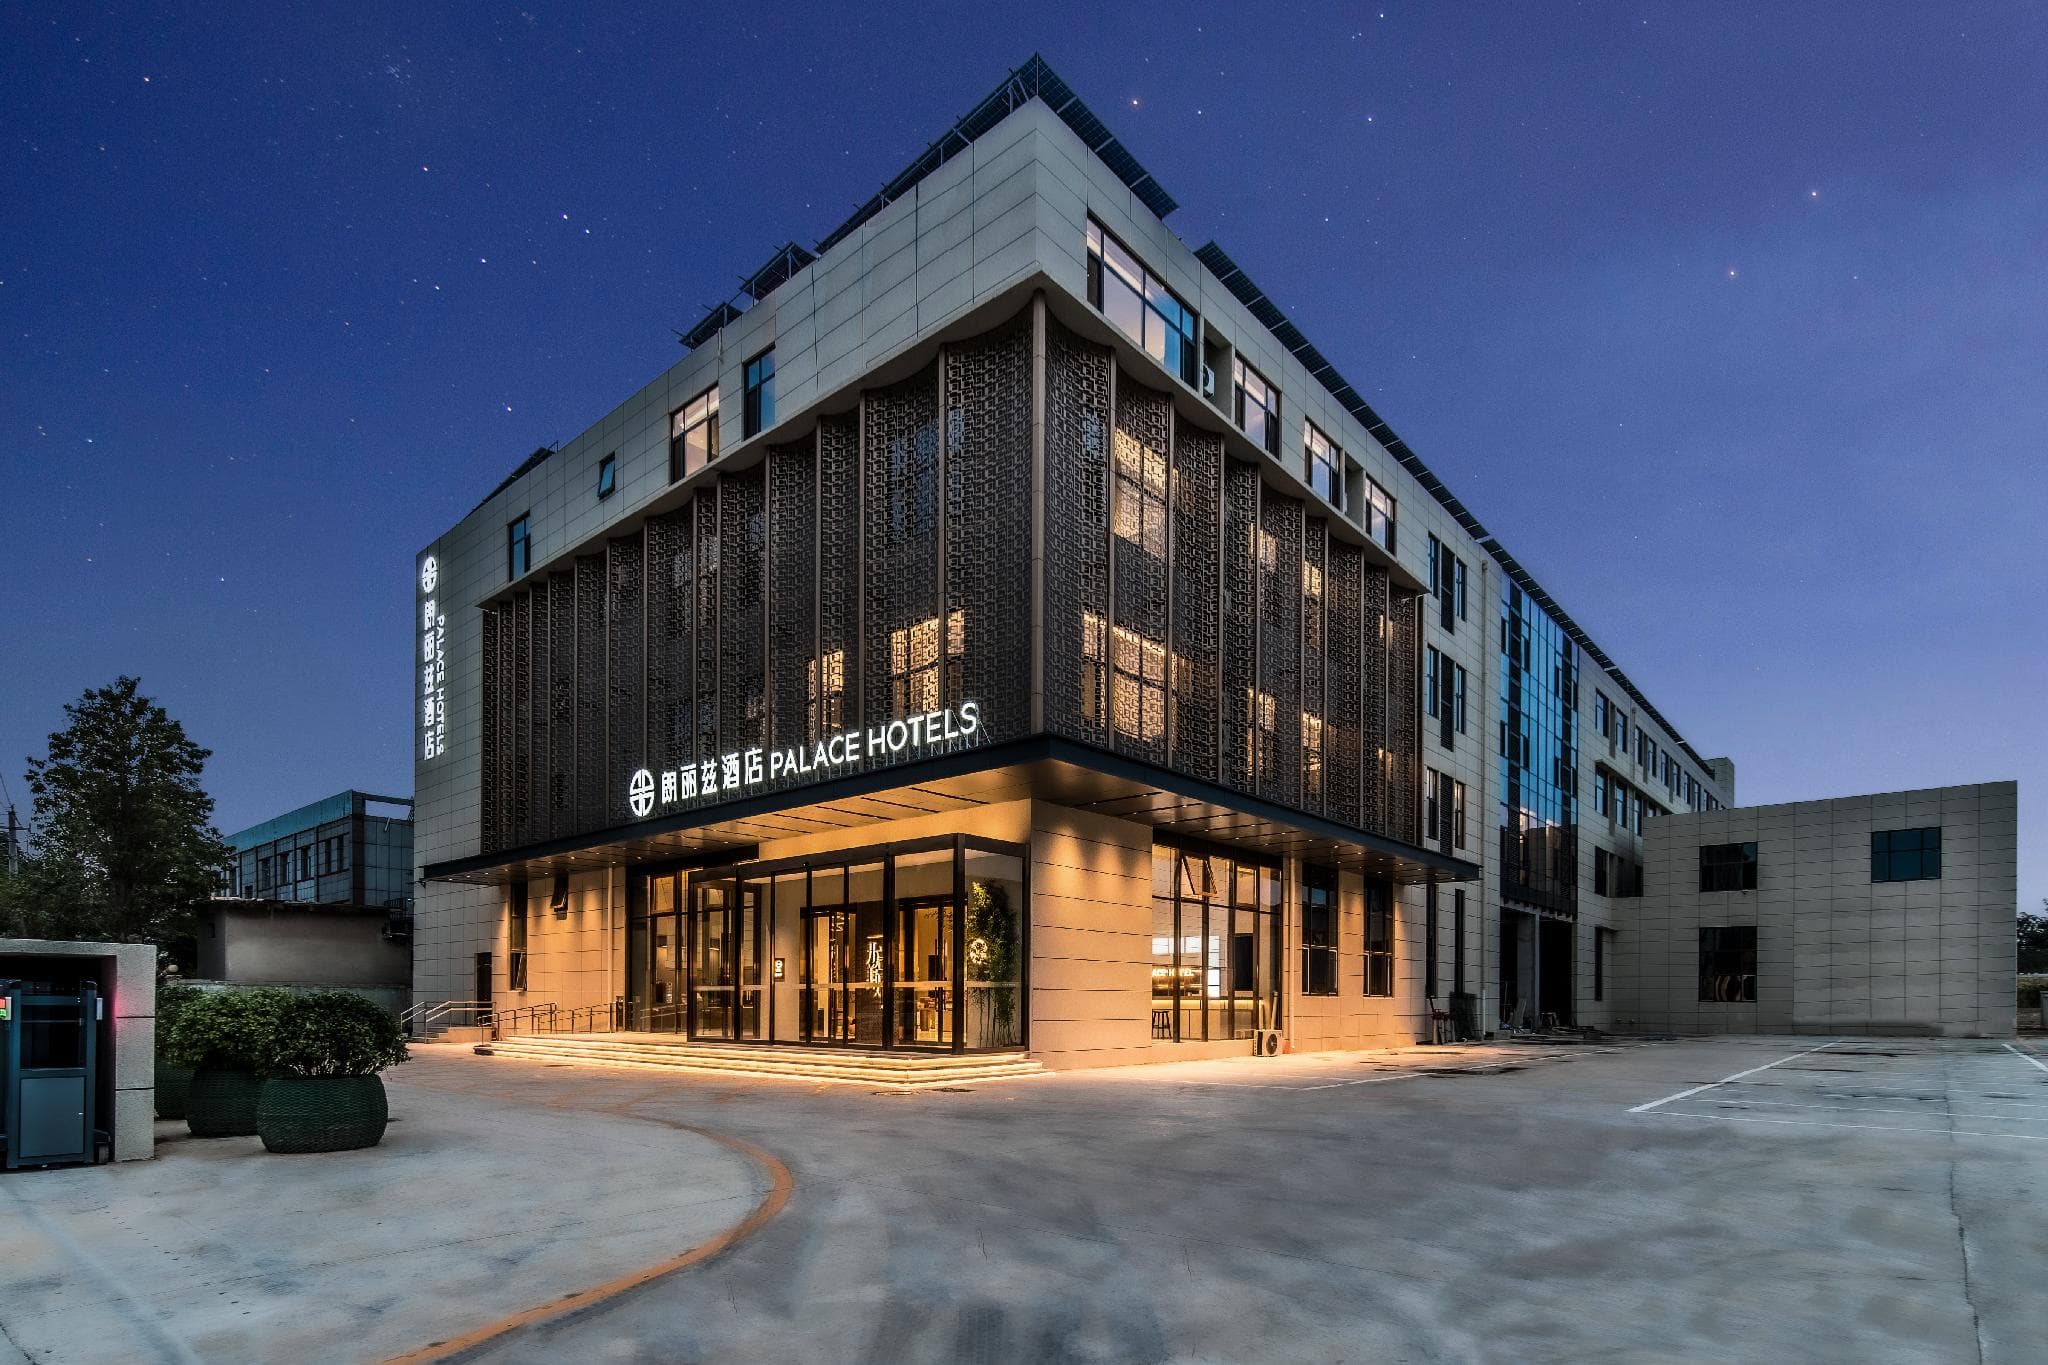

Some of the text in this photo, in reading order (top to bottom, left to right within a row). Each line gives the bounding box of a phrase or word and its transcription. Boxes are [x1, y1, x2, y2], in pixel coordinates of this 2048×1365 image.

[436, 614, 445, 755] PALACE HOTELS
[661, 747, 763, 805] 朗丽兹酒店
[770, 702, 977, 779] PALACE HOTELS
